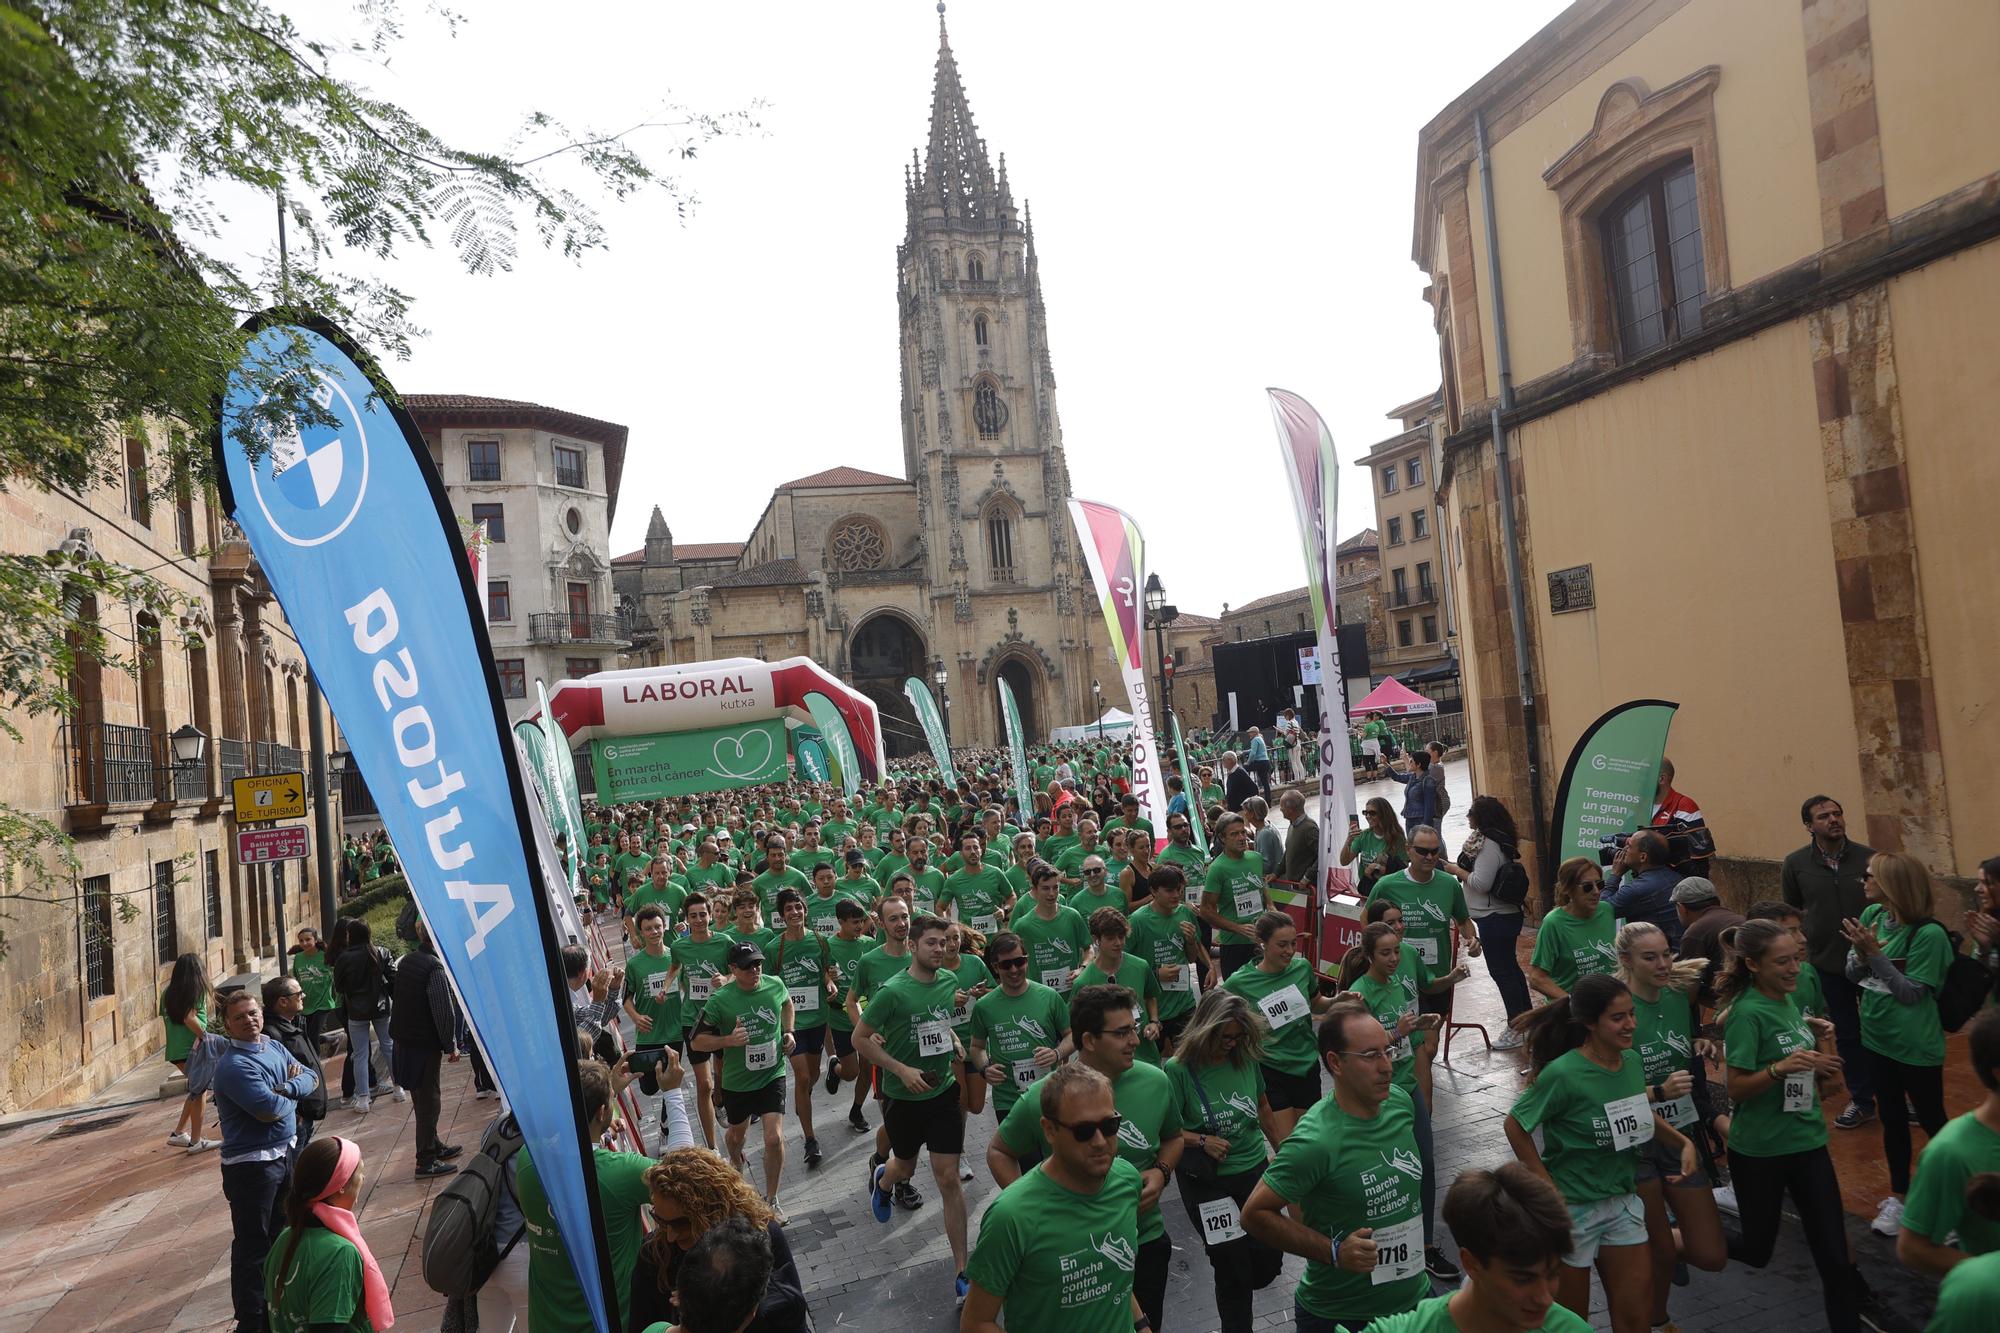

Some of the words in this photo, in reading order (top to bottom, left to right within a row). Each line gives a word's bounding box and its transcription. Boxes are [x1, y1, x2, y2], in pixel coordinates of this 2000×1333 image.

[623, 676, 753, 704] LABORAL
[720, 698, 755, 710] kutxa
[608, 767, 622, 778] En
[625, 762, 672, 775] marcha
[248, 778, 290, 788] OFICINA
[609, 775, 648, 789] contra
[650, 774, 662, 783] el
[1585, 788, 1640, 804] Tenemos
[240, 810, 253, 820] DE
[256, 806, 302, 817] TURISMO
[1582, 802, 1598, 810] un
[1600, 804, 1628, 814] gran
[1580, 814, 1624, 826] camino
[1578, 827, 1600, 836] por
[1576, 954, 1600, 964] marcha
[1046, 978, 1059, 986] 122
[692, 985, 708, 993] 1078
[1268, 1001, 1288, 1018] 900
[922, 1032, 942, 1046] 1150
[996, 1030, 1021, 1038] marcha
[1777, 1036, 1792, 1044] En
[1641, 1046, 1654, 1054] En
[1643, 1050, 1672, 1063] marcha
[750, 1053, 766, 1062] 838
[1019, 1070, 1036, 1082] 474
[1786, 1083, 1804, 1098] 894
[1592, 1120, 1608, 1128] En
[1614, 1114, 1638, 1134] 1175
[1361, 1173, 1376, 1186] En
[1364, 1175, 1400, 1196] marcha
[1366, 1188, 1398, 1206] contra
[1367, 1206, 1377, 1216] el
[1380, 1193, 1410, 1214] cáncer
[1206, 1212, 1232, 1231] 1267
[1378, 1243, 1408, 1265] 1718
[1060, 1258, 1078, 1271] En
[1062, 1261, 1103, 1283] marcha
[1062, 1276, 1098, 1294] contra
[1062, 1293, 1072, 1304] el
[1076, 1282, 1112, 1302] cáncer
